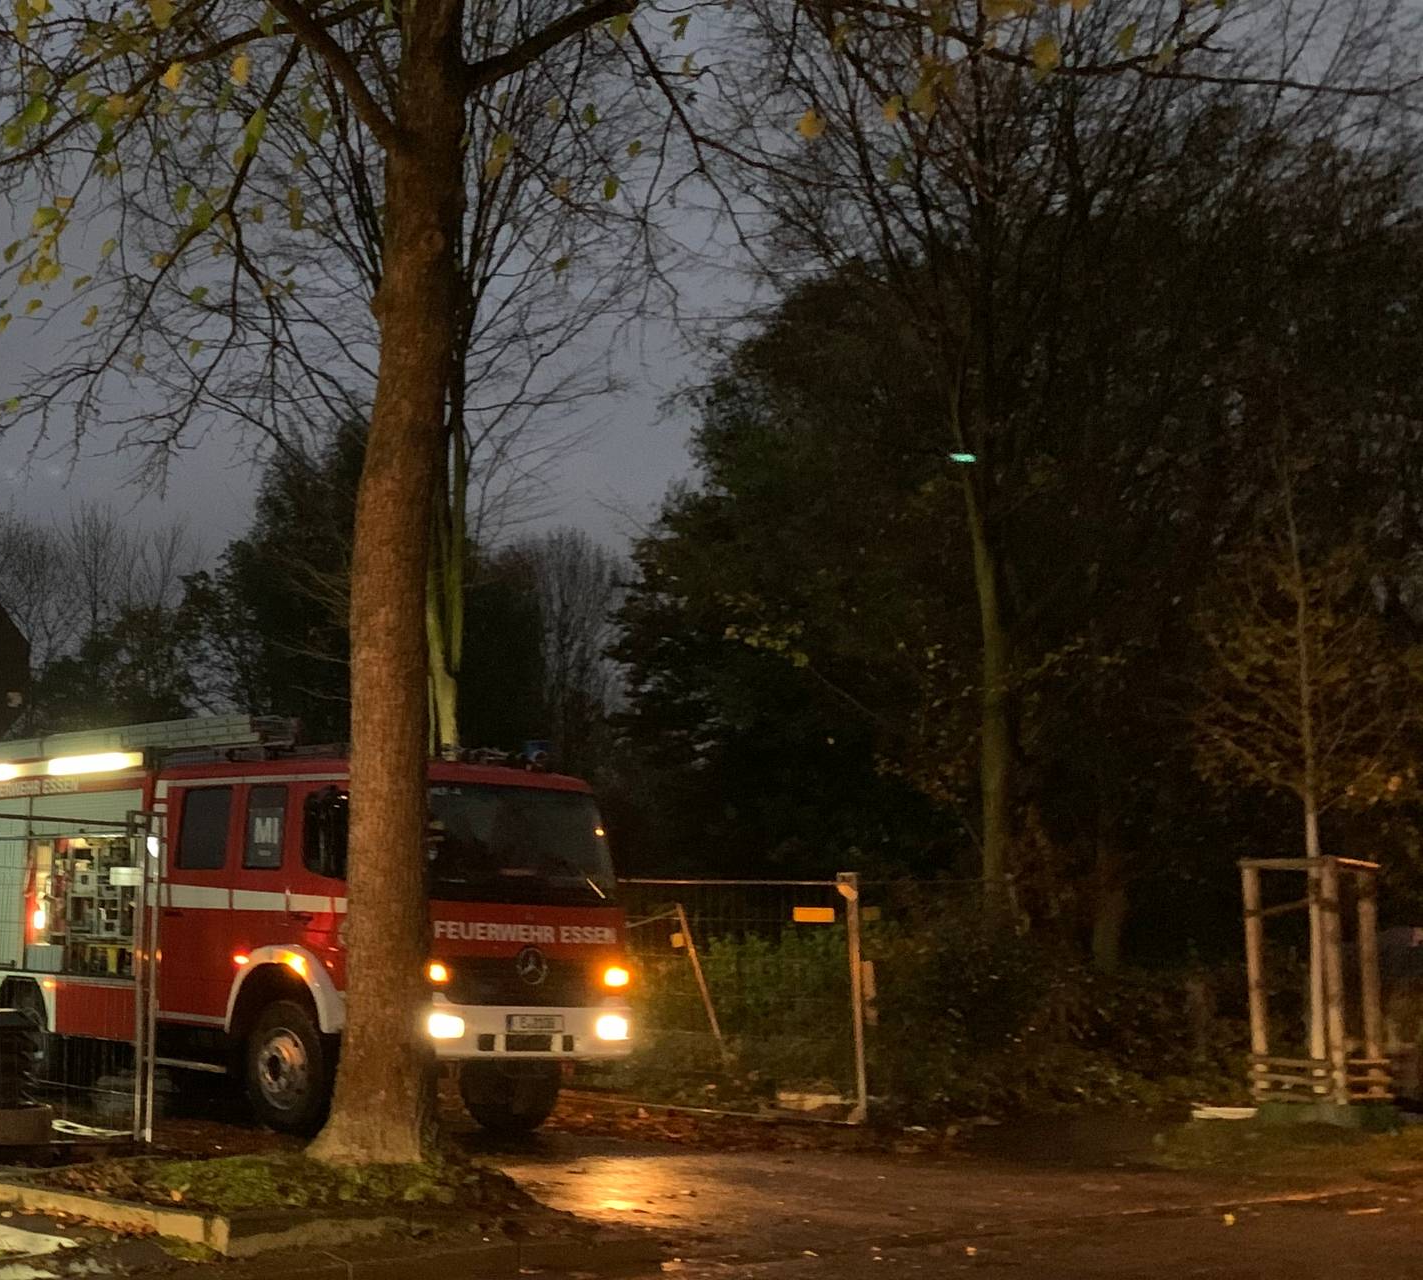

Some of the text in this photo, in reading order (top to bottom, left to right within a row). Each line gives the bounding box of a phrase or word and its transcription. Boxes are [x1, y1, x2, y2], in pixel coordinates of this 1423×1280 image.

[42, 777, 79, 795] ESSEN
[434, 920, 617, 944] FEUERWEHR ESSEN
